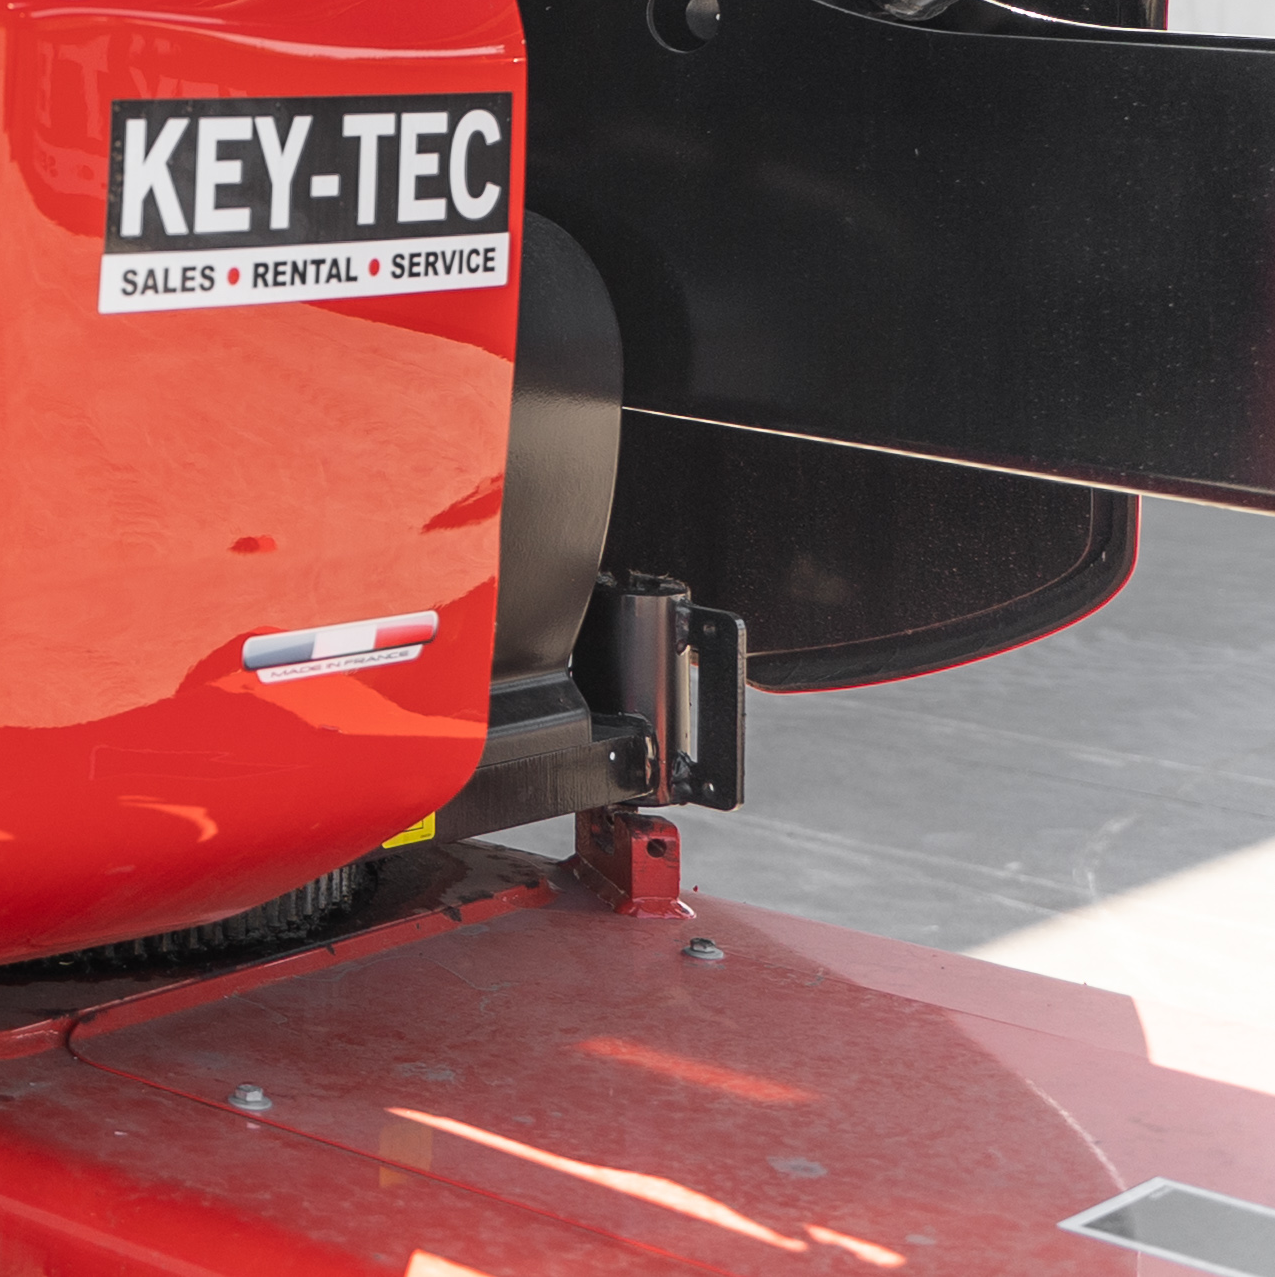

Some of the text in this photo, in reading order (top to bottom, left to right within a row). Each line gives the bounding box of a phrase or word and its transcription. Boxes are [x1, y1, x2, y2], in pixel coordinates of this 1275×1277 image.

[120, 109, 502, 237] KEY-TEC
[121, 247, 497, 297] SALES RENTAL SERVICE
[270, 649, 410, 678] MADE IN FRANCE
